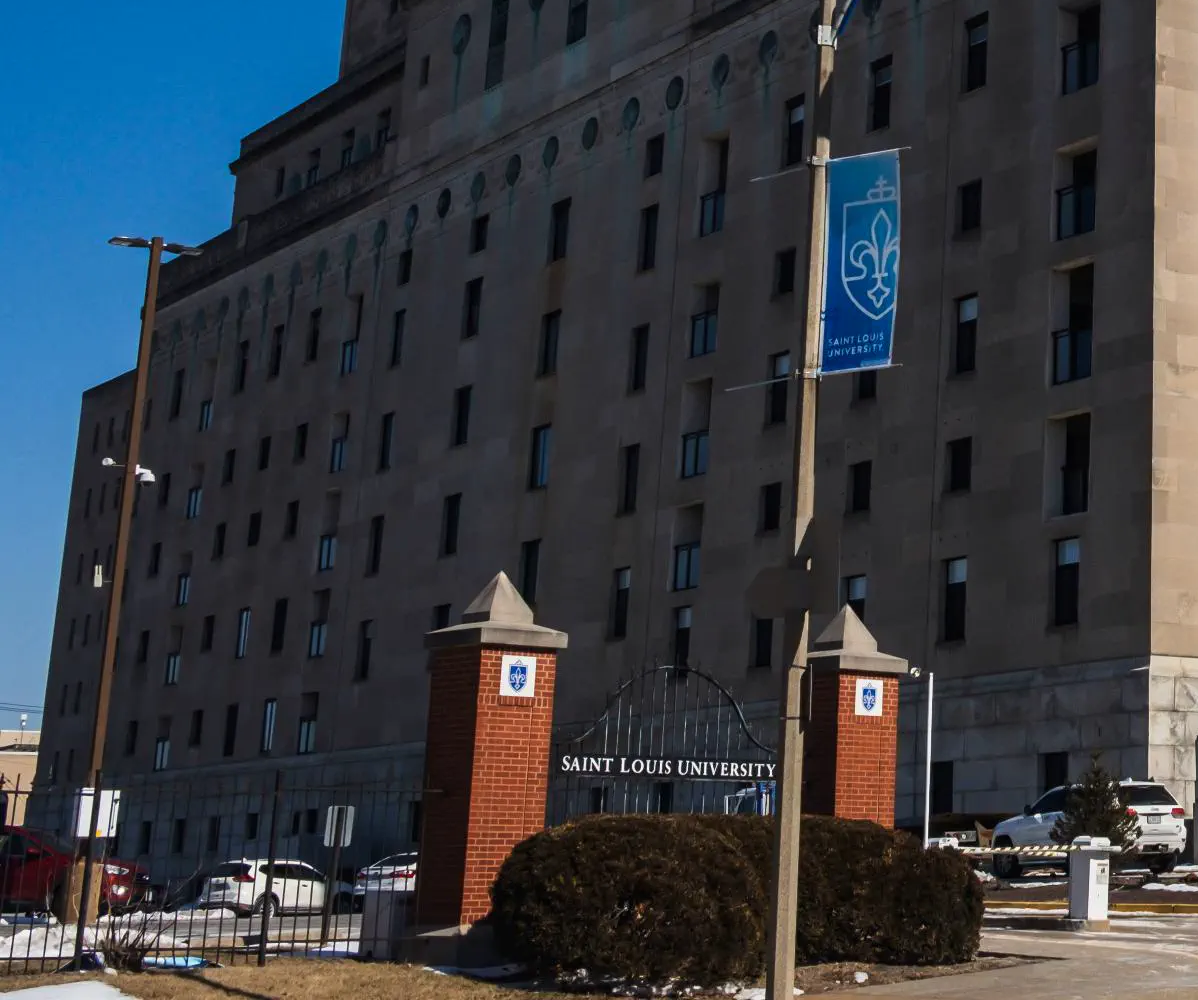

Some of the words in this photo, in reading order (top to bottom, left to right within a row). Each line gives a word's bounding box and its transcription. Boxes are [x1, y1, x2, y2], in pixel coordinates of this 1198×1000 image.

[828, 336, 855, 346] SAINT
[857, 332, 885, 343] LOUIS
[828, 343, 883, 358] UNIVERSITY
[561, 755, 614, 773] SAINT
[620, 758, 672, 775] LOUIS
[677, 760, 776, 778] UNIVERSITY
